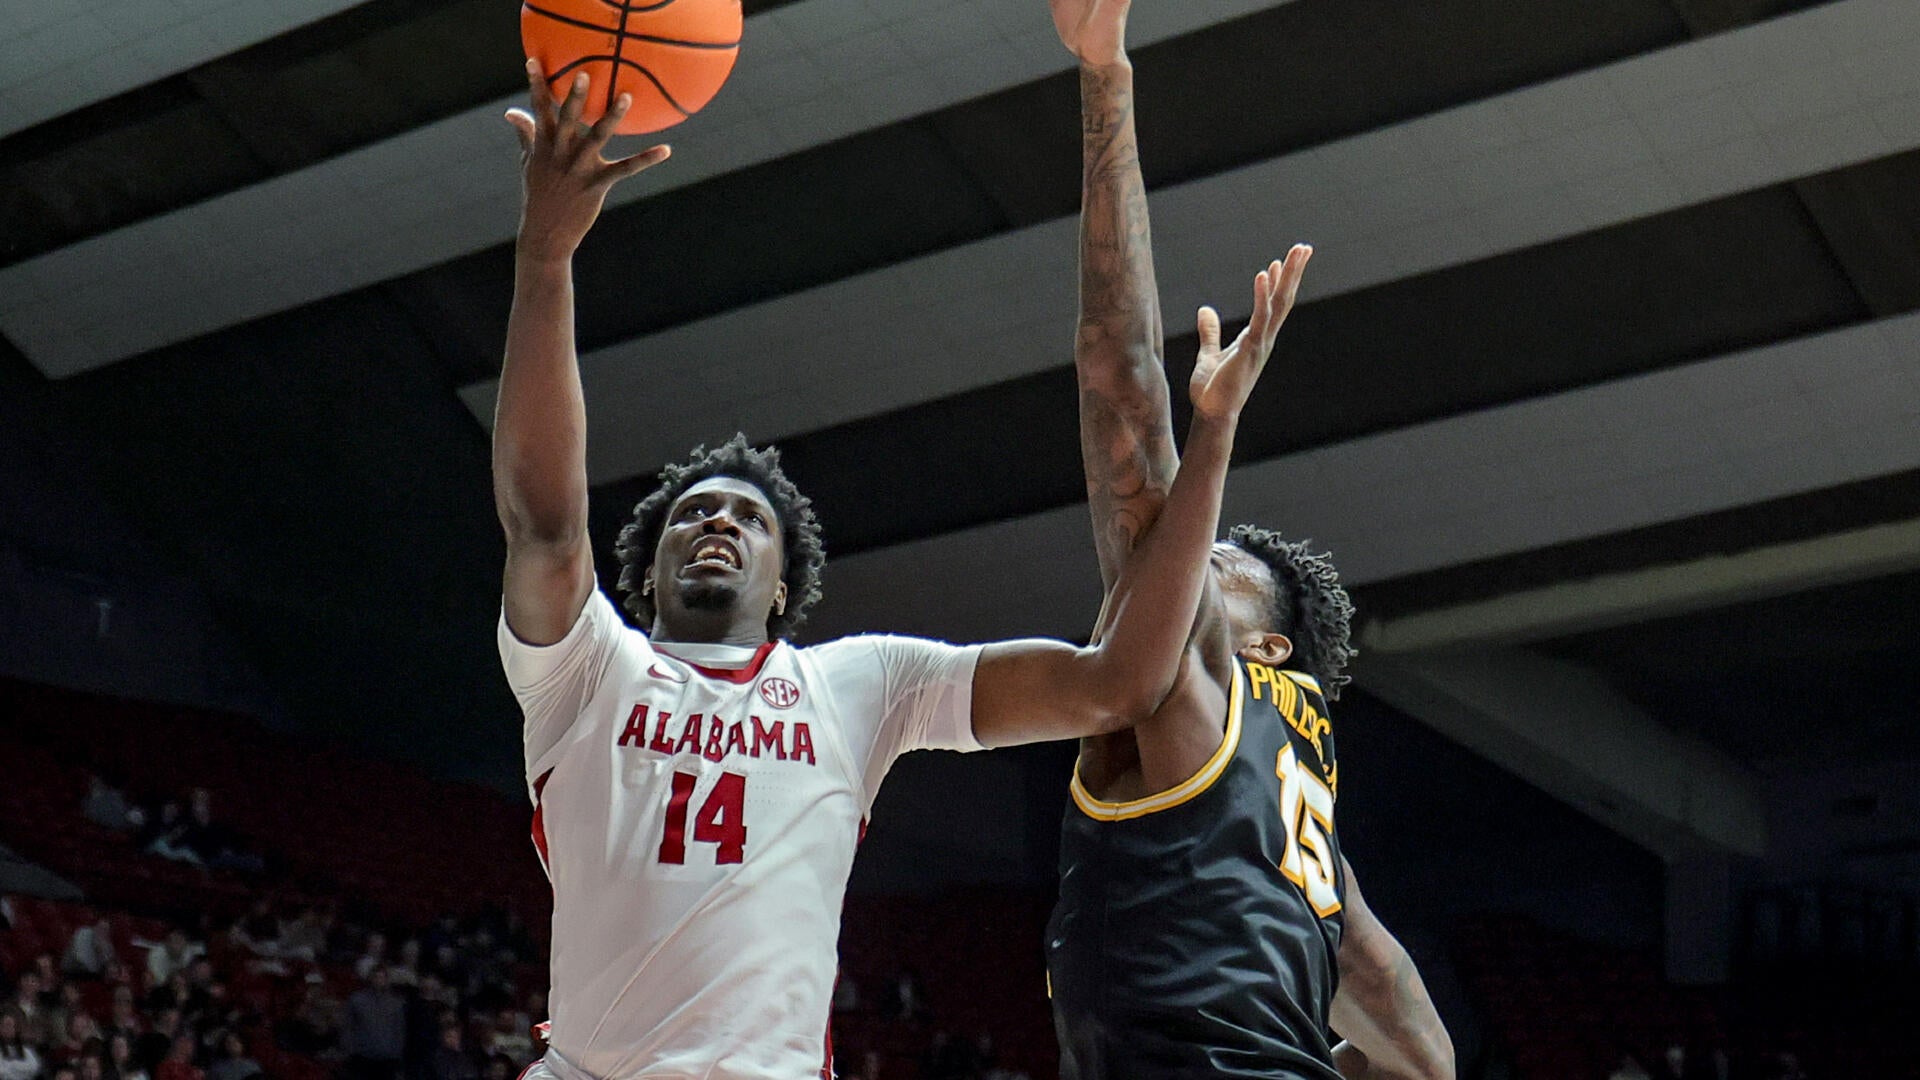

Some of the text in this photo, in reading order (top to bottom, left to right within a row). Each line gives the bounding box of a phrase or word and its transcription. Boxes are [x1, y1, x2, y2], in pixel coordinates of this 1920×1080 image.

[762, 678, 798, 707] SEC
[617, 704, 816, 766] ALABAMA
[658, 771, 747, 865] 14
[1276, 741, 1342, 919] 15
